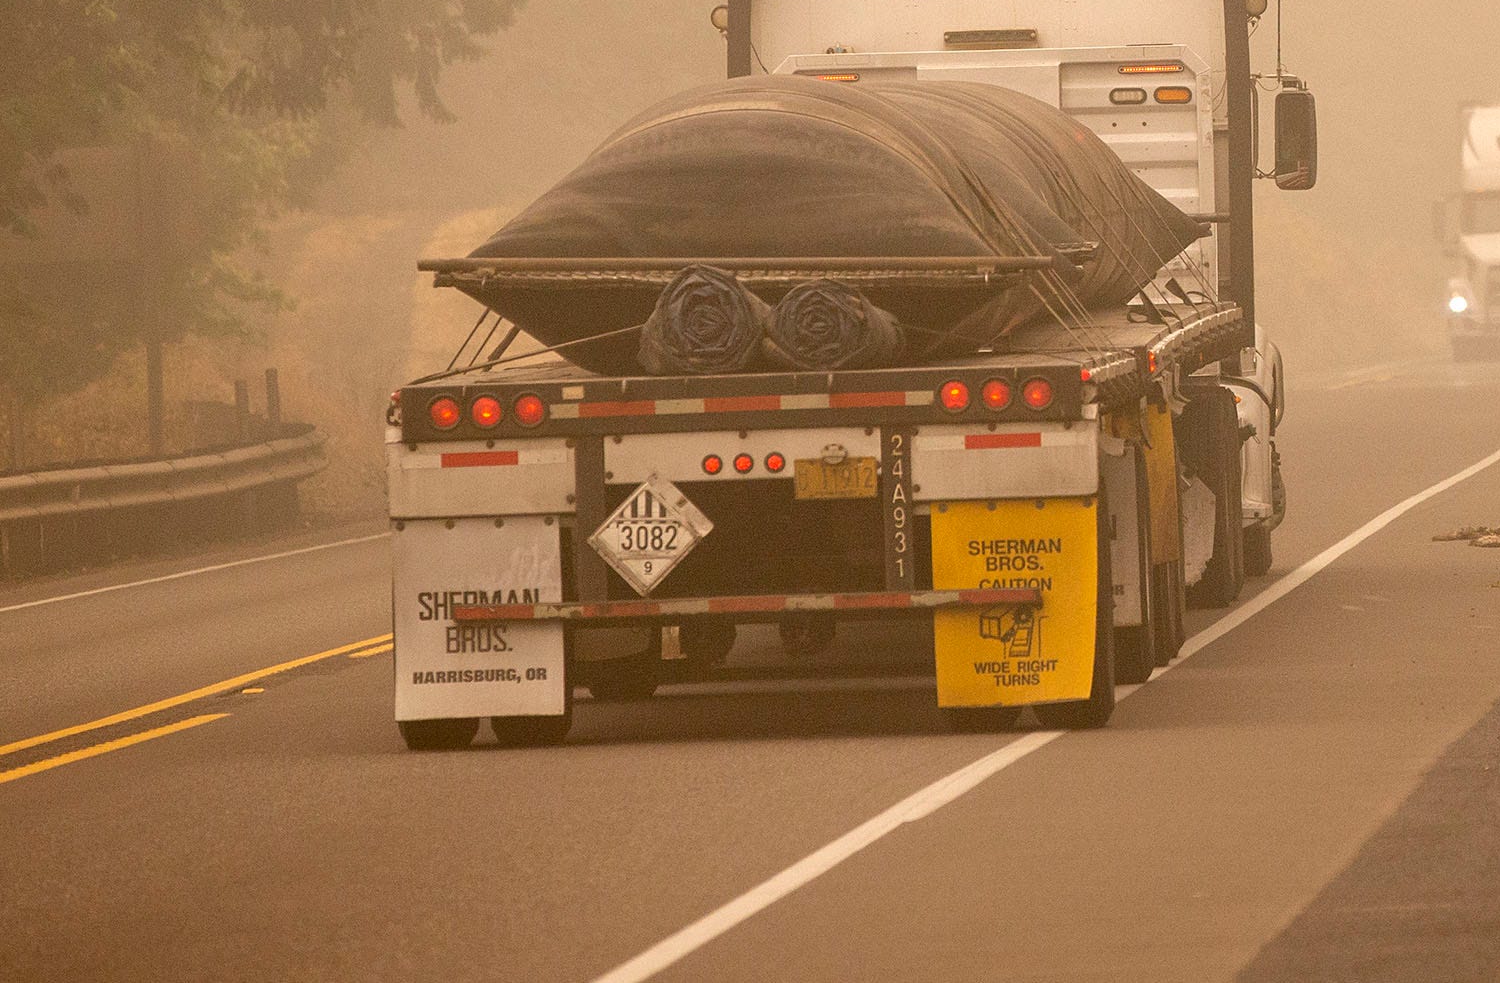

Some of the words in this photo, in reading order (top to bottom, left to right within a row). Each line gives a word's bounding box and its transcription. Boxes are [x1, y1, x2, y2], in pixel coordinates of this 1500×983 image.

[620, 525, 678, 551] 3082
[968, 538, 1062, 556] SHERMAN
[644, 560, 653, 574] 9
[986, 556, 1044, 572] BROS.
[979, 577, 1052, 592] CAUTION
[446, 625, 513, 654] BROS.
[974, 661, 1010, 675] WIDE
[1017, 659, 1058, 673] RIGHT
[412, 668, 521, 684] HARRISBURG,
[525, 667, 547, 681] OR
[994, 674, 1040, 687] TURNS
